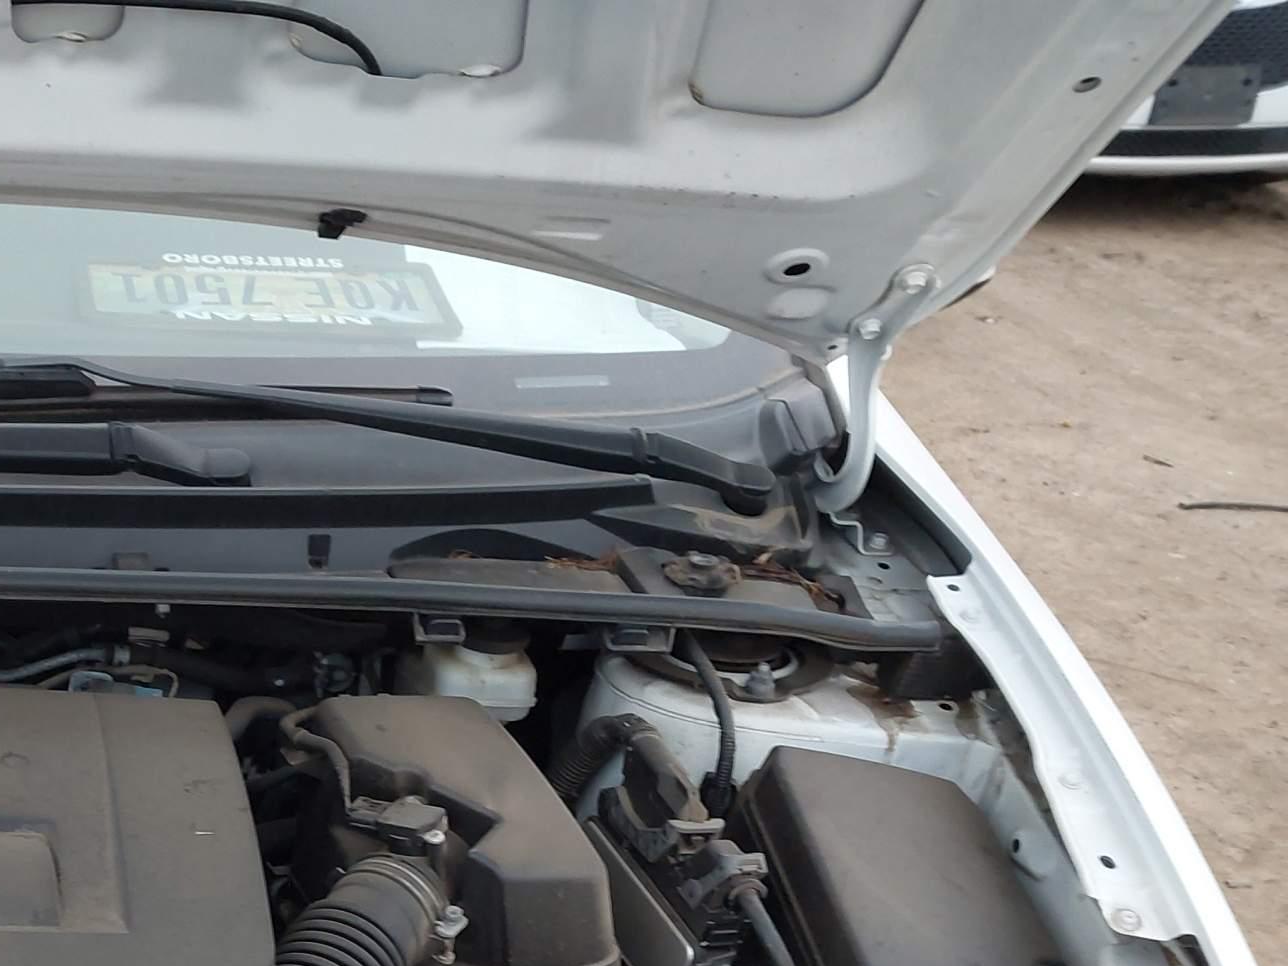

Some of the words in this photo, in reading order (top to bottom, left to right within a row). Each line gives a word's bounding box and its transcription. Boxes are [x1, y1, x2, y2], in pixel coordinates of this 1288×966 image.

[161, 252, 344, 268] STREETSBORO
[111, 272, 273, 306] 7501
[175, 310, 373, 326] NISSAN
